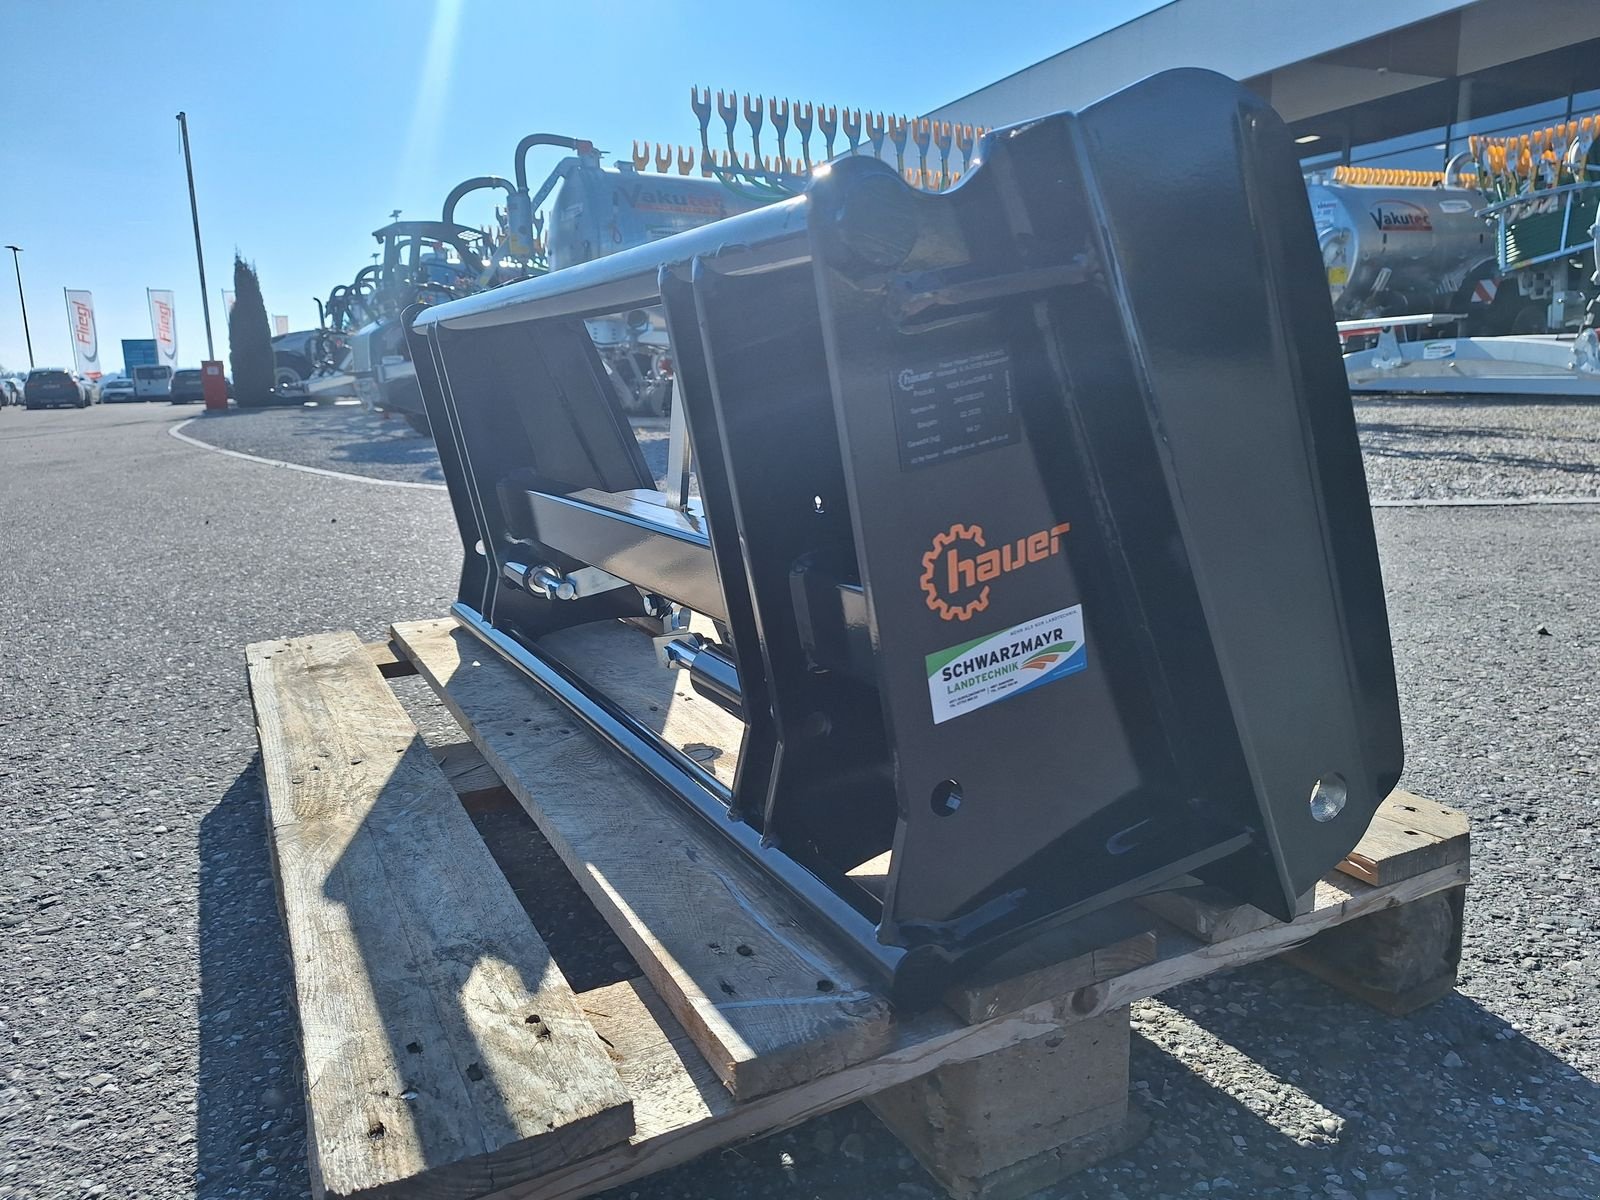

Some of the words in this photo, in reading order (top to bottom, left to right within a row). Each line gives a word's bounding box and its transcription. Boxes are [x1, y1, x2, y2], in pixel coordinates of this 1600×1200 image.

[617, 183, 721, 208] Vakutec
[1369, 208, 1431, 230] Vakutec
[72, 300, 91, 344] Fliegl
[154, 300, 173, 343] Fliegl
[947, 522, 1071, 594] hauer
[942, 627, 1064, 682] SCHWARZMAYR
[946, 661, 1020, 695] LANDTECHNIK
